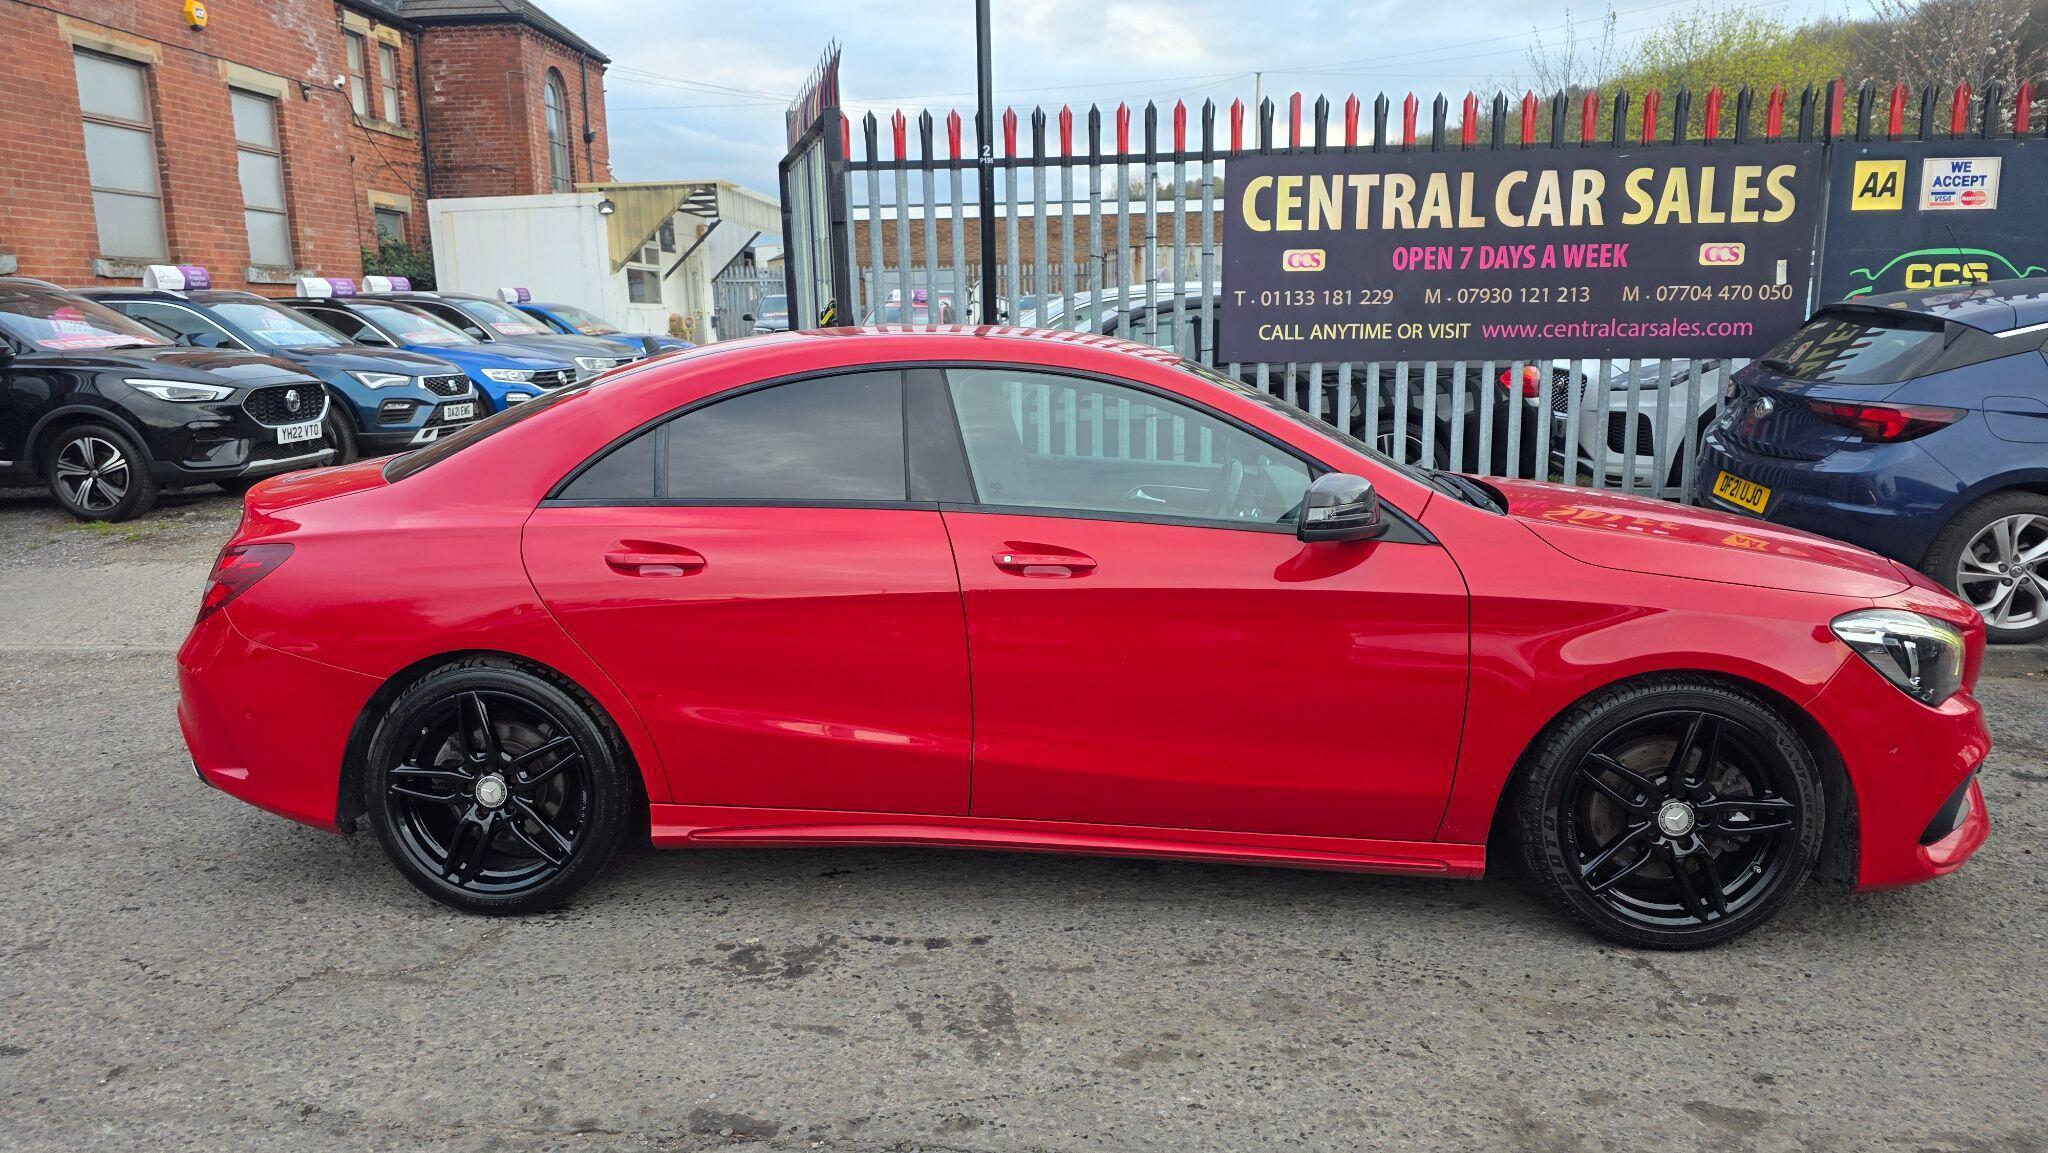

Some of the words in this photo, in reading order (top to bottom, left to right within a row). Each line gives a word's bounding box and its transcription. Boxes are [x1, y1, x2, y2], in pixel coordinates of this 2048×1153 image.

[982, 144, 991, 157] 2
[1951, 161, 1973, 173] WE
[1858, 172, 1898, 198] AA
[1932, 175, 1988, 187] ACCEPT
[1242, 172, 1486, 232] CENTRAL
[1495, 168, 1606, 228] CAR
[1621, 164, 1797, 225] SALES
[1934, 194, 1952, 202] VISA
[1392, 246, 1453, 271] OPEN
[1460, 246, 1473, 270] 7
[1479, 245, 1536, 270] DAYS
[1541, 245, 1556, 269] A
[1562, 243, 1629, 268] WEEK
[1905, 263, 1988, 289] CCS
[1261, 289, 1315, 306] 01133
[1323, 289, 1352, 306] 181
[1359, 289, 1394, 305] 229
[1457, 287, 1513, 304] 07930
[1519, 287, 1549, 303] 121
[1556, 287, 1590, 303] 213
[1656, 285, 1713, 302] 07704
[1717, 284, 1753, 301] 470
[1759, 284, 1793, 300] 050
[1258, 324, 1305, 341] CALL
[1309, 323, 1393, 341] ANYTIME
[1397, 323, 1423, 339] OR
[1427, 322, 1472, 339] VISIT
[1481, 317, 1754, 338] www.centralcarsales.com
[281, 426, 303, 440] YH22
[304, 423, 320, 437] VTO
[1719, 475, 1741, 497] DF21
[1740, 483, 1763, 506] UJO
